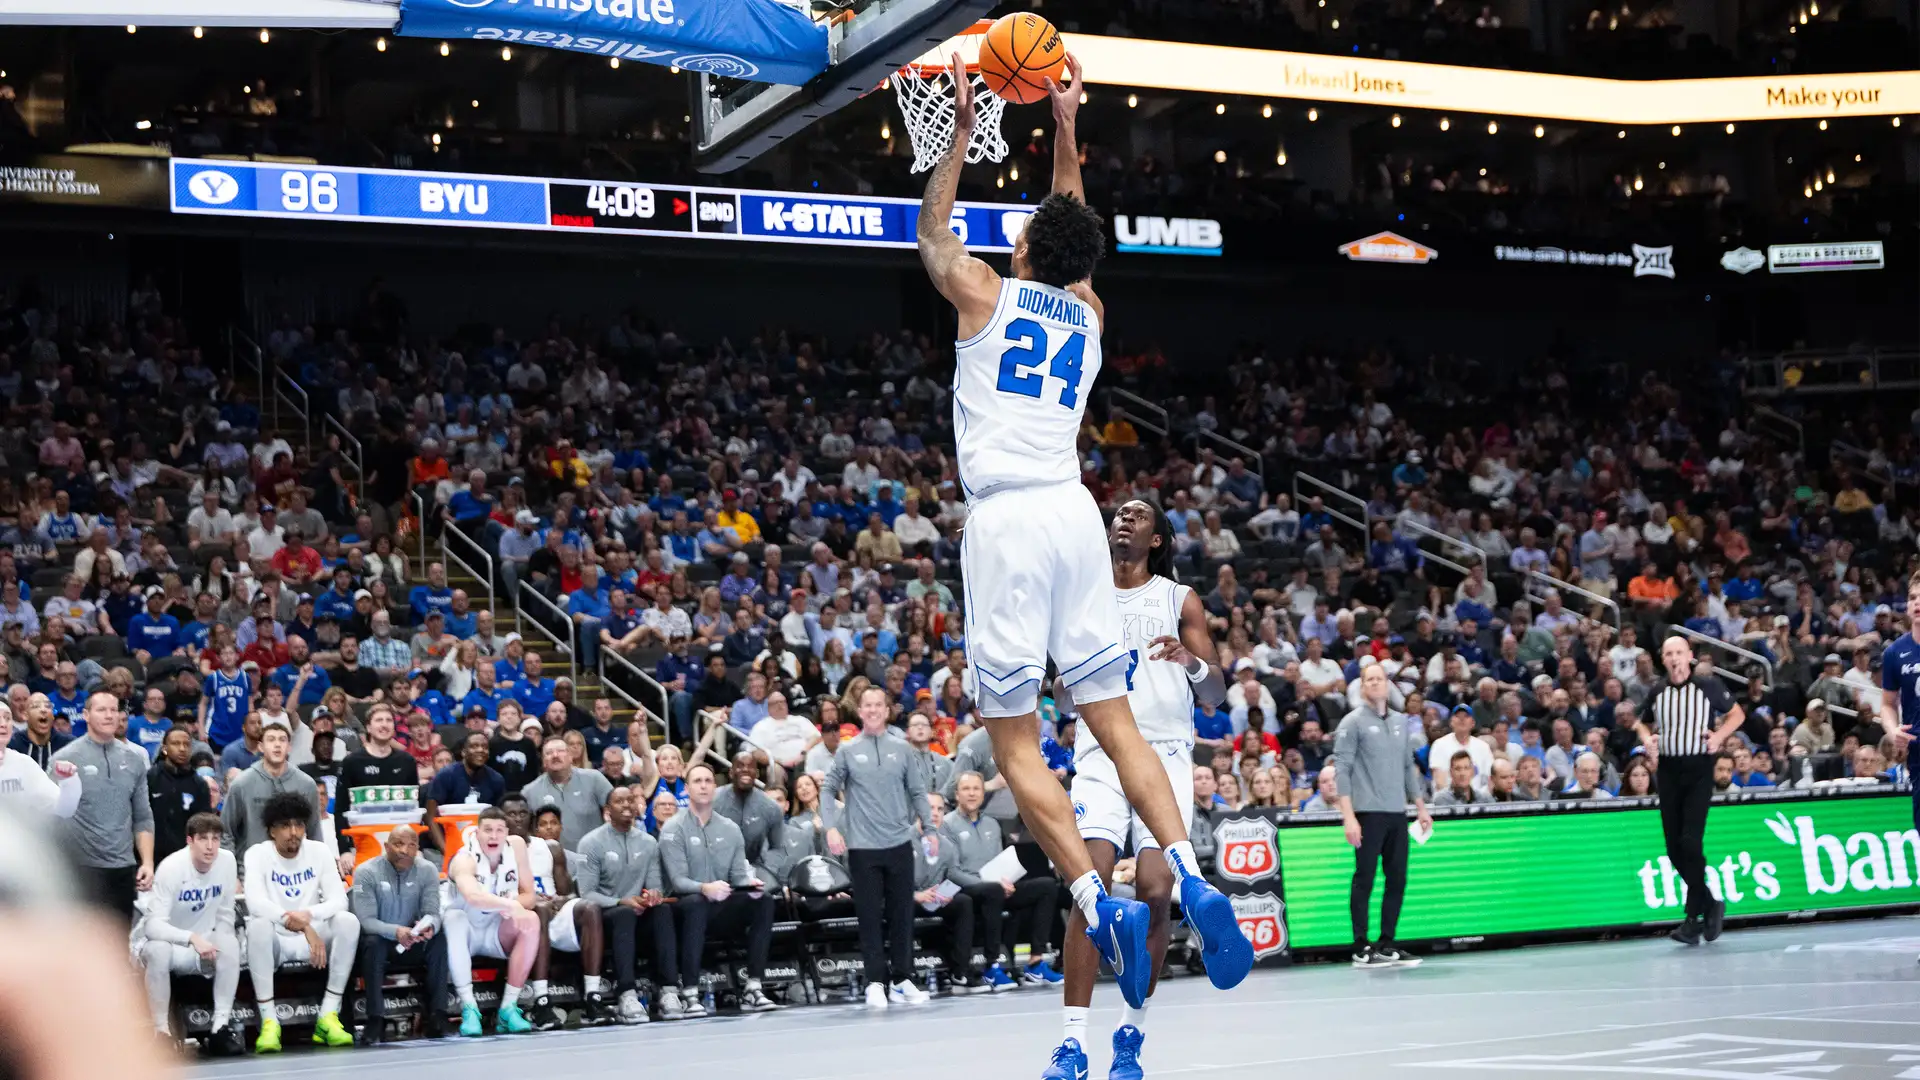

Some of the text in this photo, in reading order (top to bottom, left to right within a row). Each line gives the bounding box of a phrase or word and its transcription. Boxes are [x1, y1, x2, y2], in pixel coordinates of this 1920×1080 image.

[473, 27, 677, 59] Allstate
[1353, 71, 1406, 93] Jones
[1766, 86, 1881, 109] Make your
[0, 166, 76, 182] NIVERSITY OF
[6, 179, 54, 193] HEALTH
[56, 181, 100, 195] SYSTEM
[281, 171, 338, 213] 96
[420, 181, 488, 215] BYU
[586, 185, 655, 218] 4:09
[699, 201, 735, 222] 2ND
[762, 201, 884, 236] K-STATE
[948, 208, 969, 245] 5
[1114, 214, 1223, 248] UMB
[1017, 287, 1088, 328] DIOMANDE
[996, 317, 1086, 410] 24
[1123, 613, 1164, 641] YU
[218, 685, 244, 698] BYU
[226, 697, 237, 713] 3
[1224, 827, 1268, 838] PHILLIPS
[1228, 844, 1266, 870] 66
[271, 870, 293, 886] LOCK
[293, 872, 302, 885] IT
[178, 888, 204, 902] LOCK
[1233, 903, 1275, 915] PHILLIPS
[1239, 920, 1273, 944] 66
[764, 967, 797, 977] llstate
[836, 960, 864, 970] Allsta
[699, 973, 726, 983] state
[548, 985, 575, 995] state
[295, 1004, 321, 1016] Allst
[384, 996, 418, 1009] llstate
